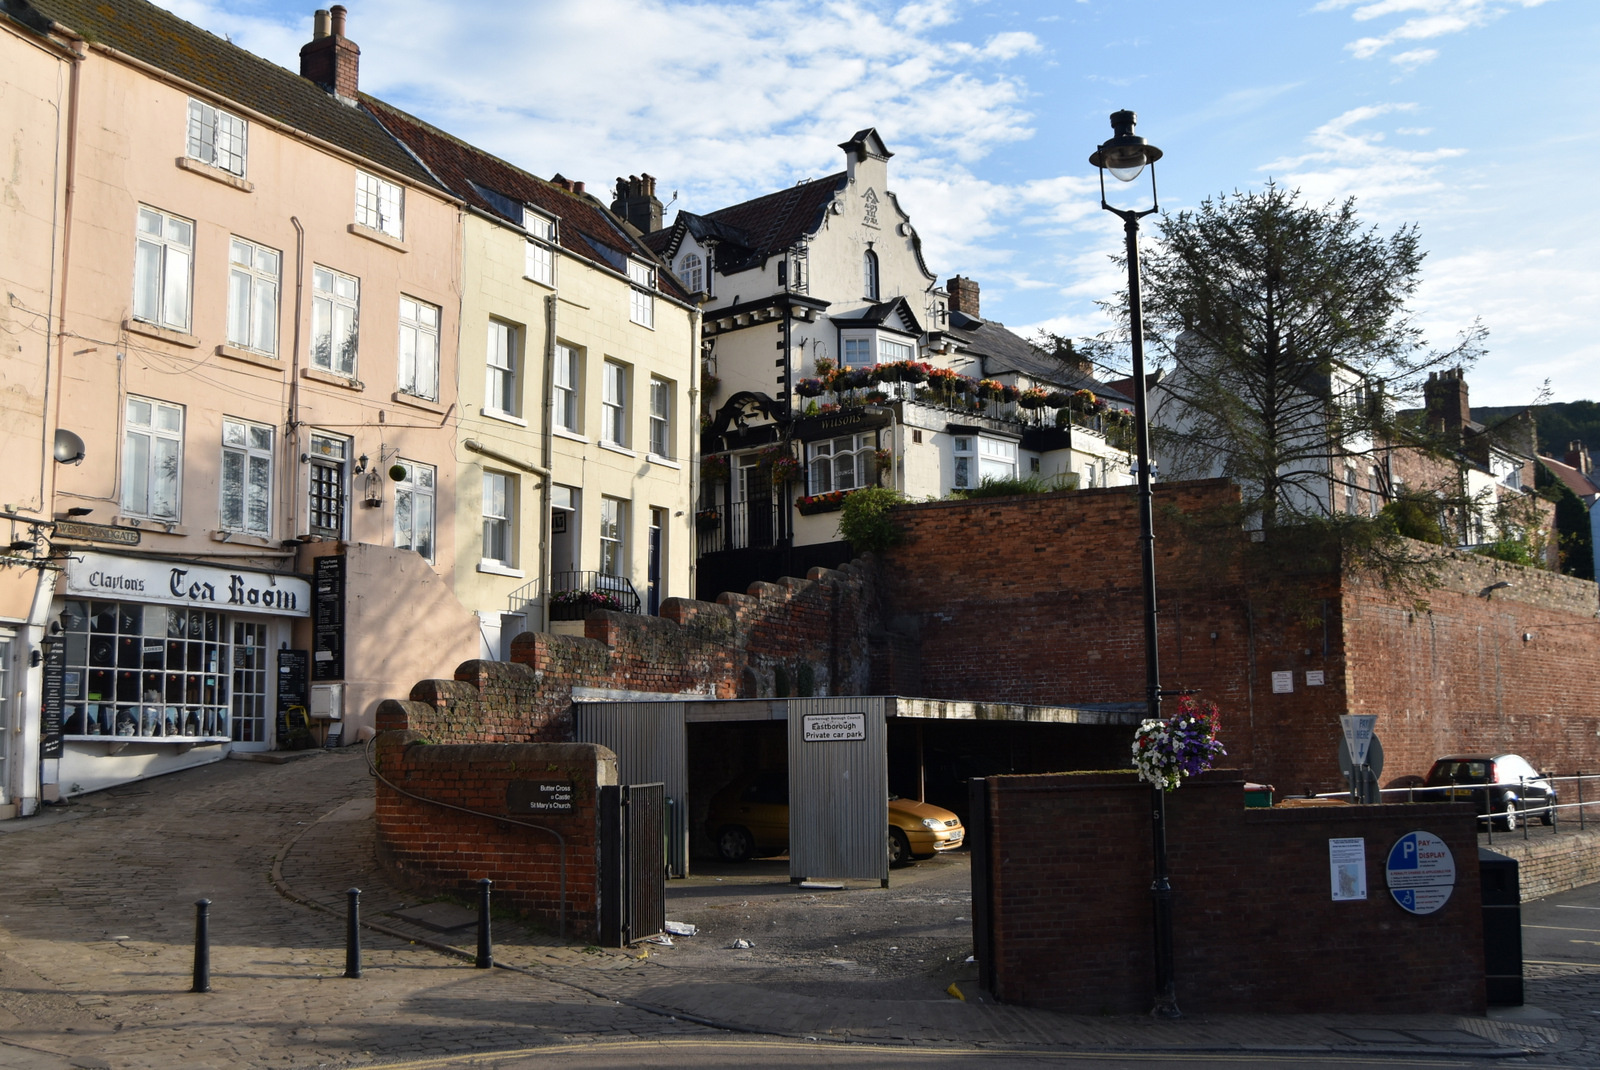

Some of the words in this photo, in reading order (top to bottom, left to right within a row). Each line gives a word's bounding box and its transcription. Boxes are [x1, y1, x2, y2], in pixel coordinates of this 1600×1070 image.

[58, 523, 83, 535] WEST
[88, 526, 137, 542] SANDGATE
[89, 570, 145, 592] Clayton's
[170, 567, 215, 602] Tea
[228, 574, 297, 610] Room
[812, 722, 856, 730] Eastborough
[1153, 809, 1160, 820] 5
[1403, 841, 1415, 859] P
